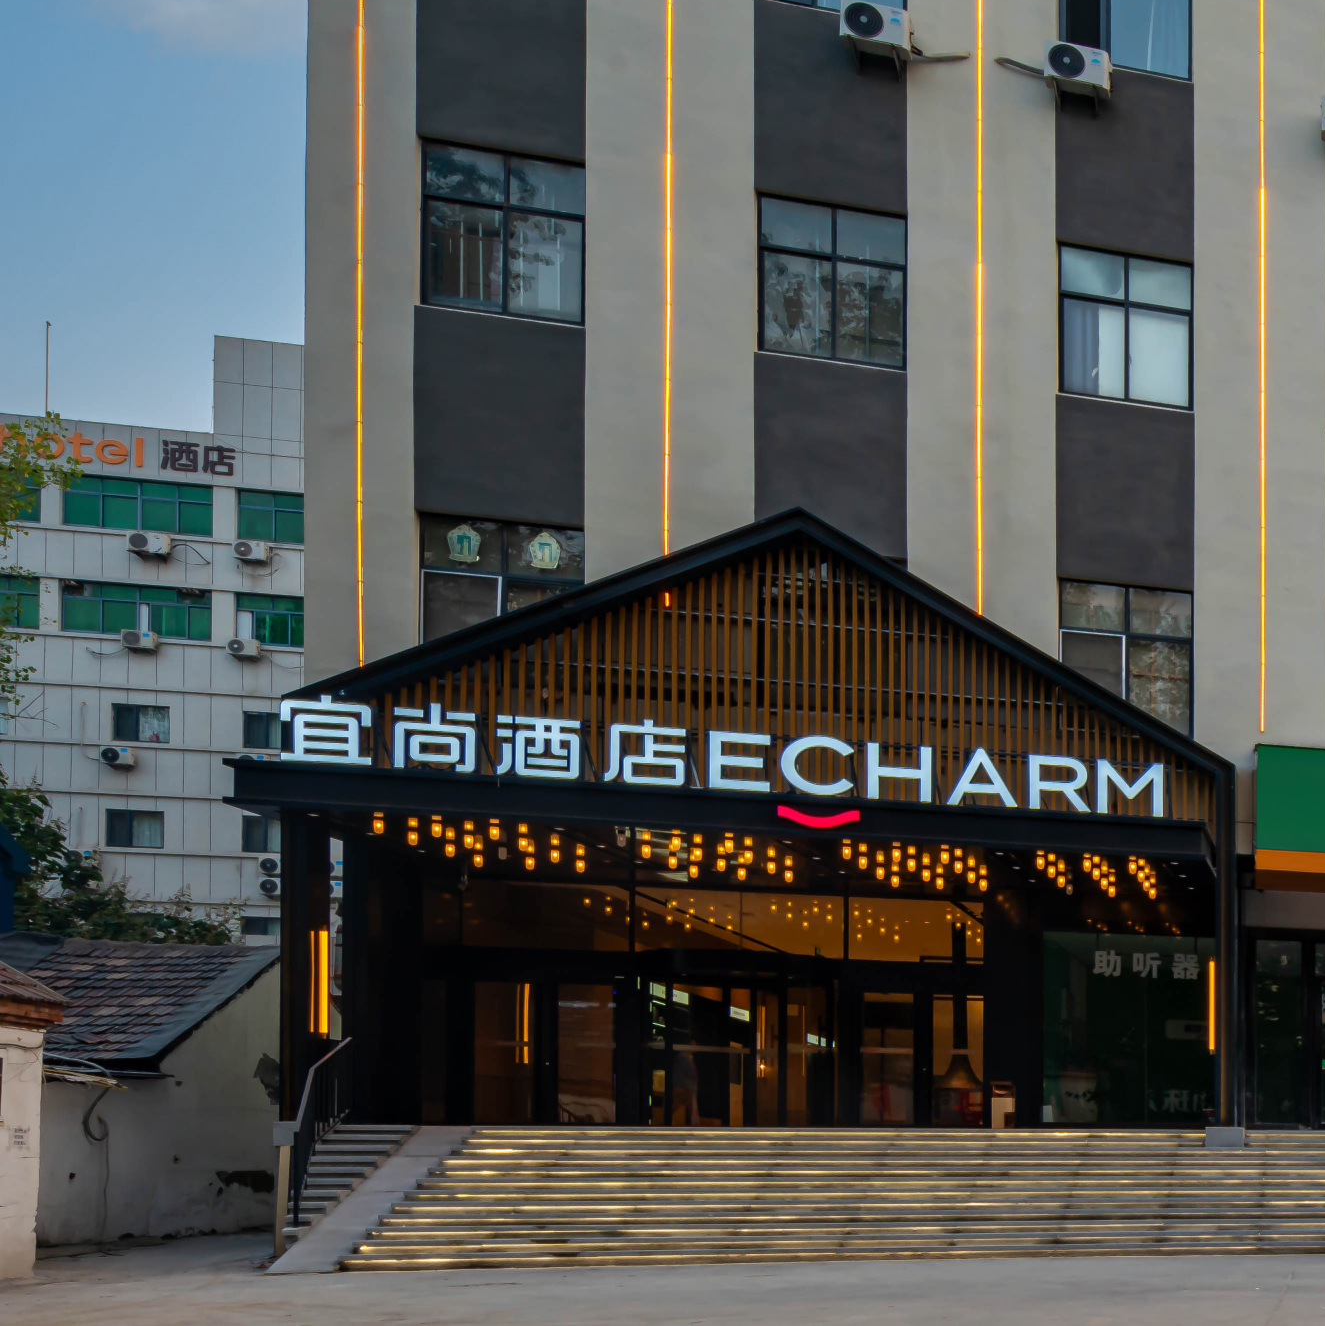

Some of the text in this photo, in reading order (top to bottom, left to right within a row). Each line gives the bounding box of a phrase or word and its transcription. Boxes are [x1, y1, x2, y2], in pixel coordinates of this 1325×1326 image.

[161, 439, 236, 476] 酒店
[279, 695, 1165, 819] 宜尚酒店 ECHARM
[1093, 950, 1200, 980] 助听器
